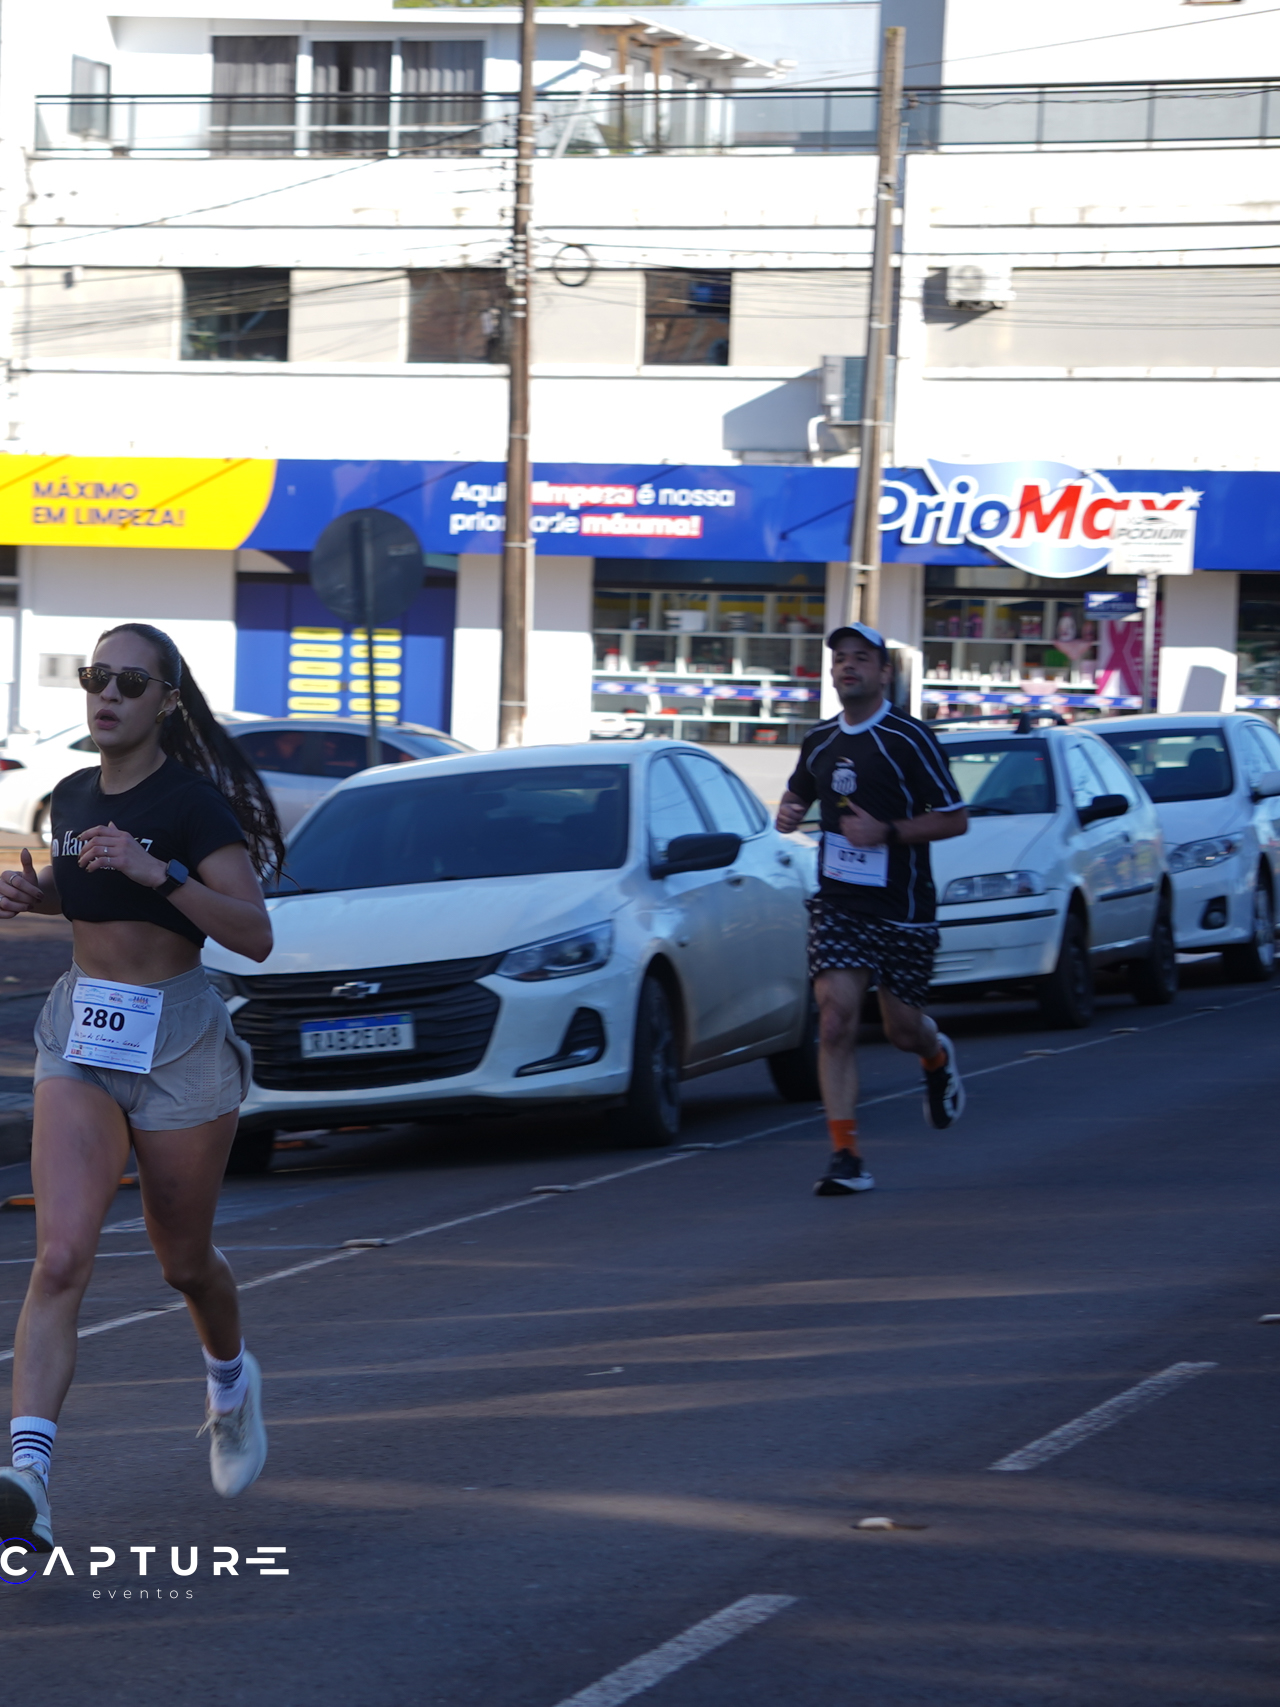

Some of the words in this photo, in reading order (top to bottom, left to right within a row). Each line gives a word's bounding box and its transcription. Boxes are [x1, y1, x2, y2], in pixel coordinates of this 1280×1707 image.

[32, 475, 139, 500] MÁXIMO
[451, 481, 507, 508] Aqui
[658, 488, 736, 507] nossa
[32, 506, 66, 526] EM
[75, 507, 186, 528] LIMPEZA!
[878, 475, 1188, 546] PrioMa
[82, 1007, 125, 1031] 280
